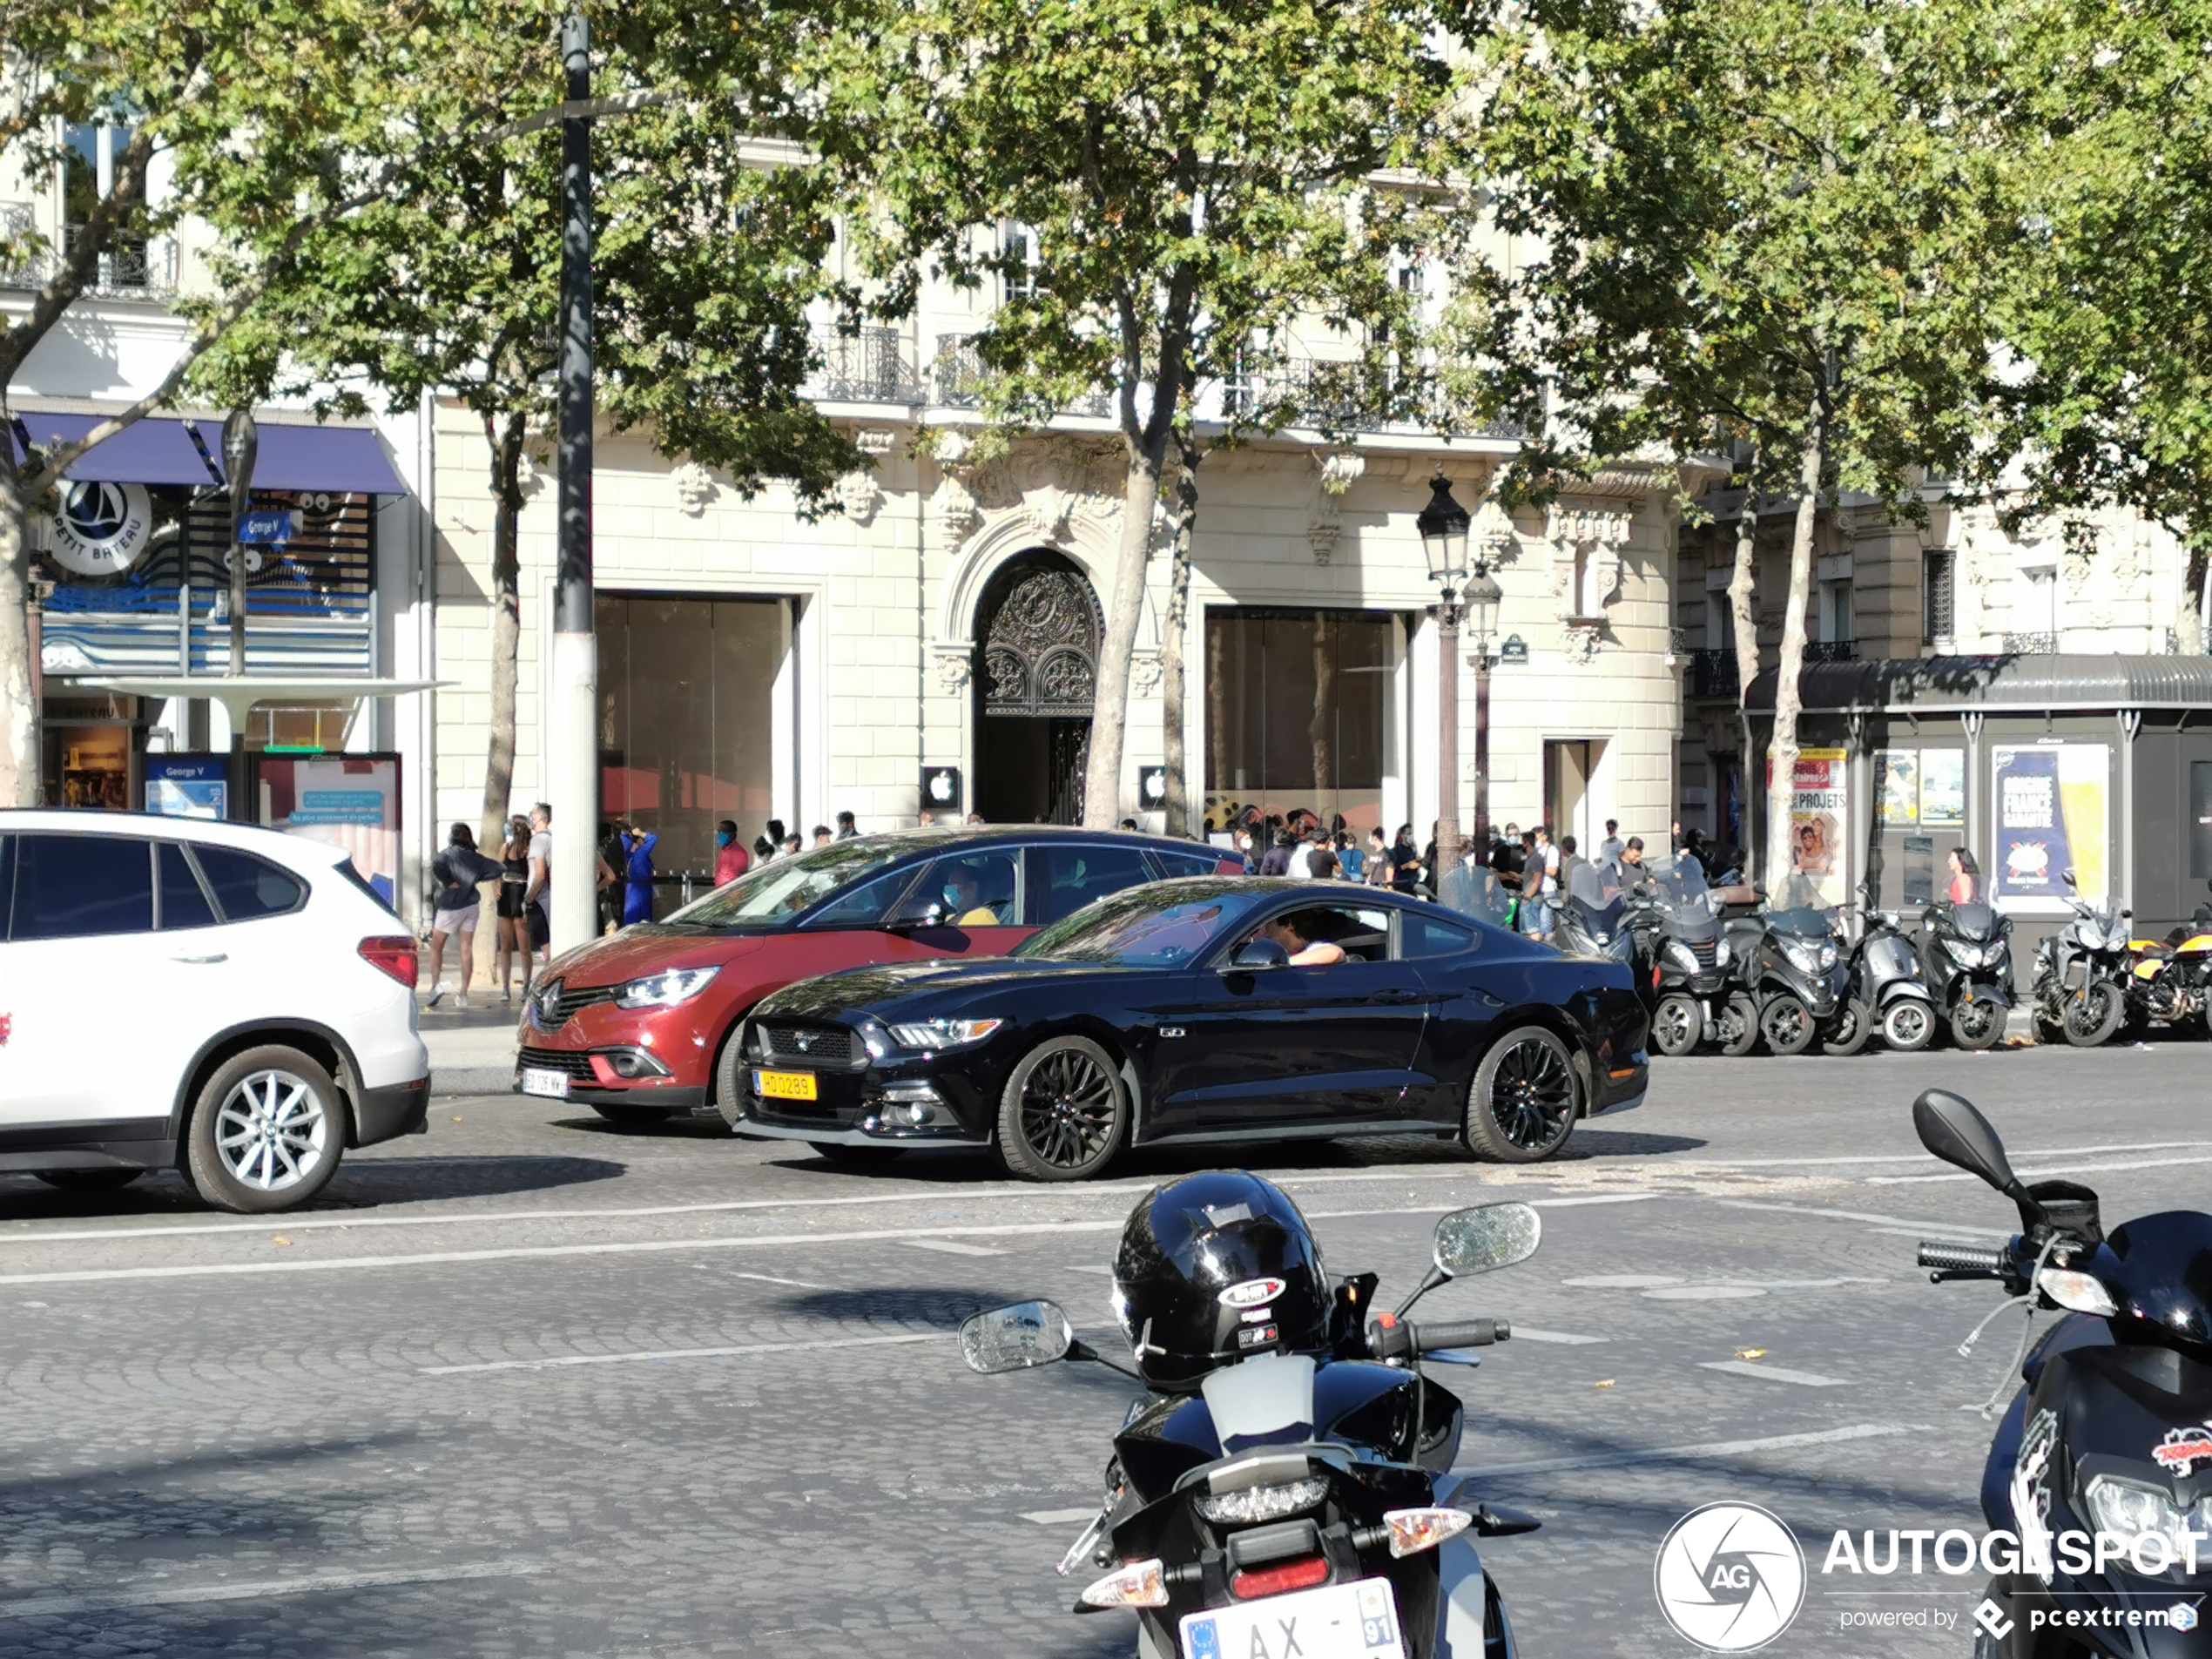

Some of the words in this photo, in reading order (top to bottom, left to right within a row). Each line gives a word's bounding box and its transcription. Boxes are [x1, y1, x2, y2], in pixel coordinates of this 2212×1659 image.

[248, 521, 272, 536] George
[273, 520, 280, 531] V
[54, 517, 86, 556] PETIT
[92, 519, 142, 559] BATEAU
[165, 767, 196, 778] George
[197, 767, 205, 776] V
[1799, 792, 1846, 810] PROJETS
[2004, 793, 2053, 813] FRANCE
[1240, 1332, 1253, 1343] DOT
[1365, 1617, 1393, 1644] 91
